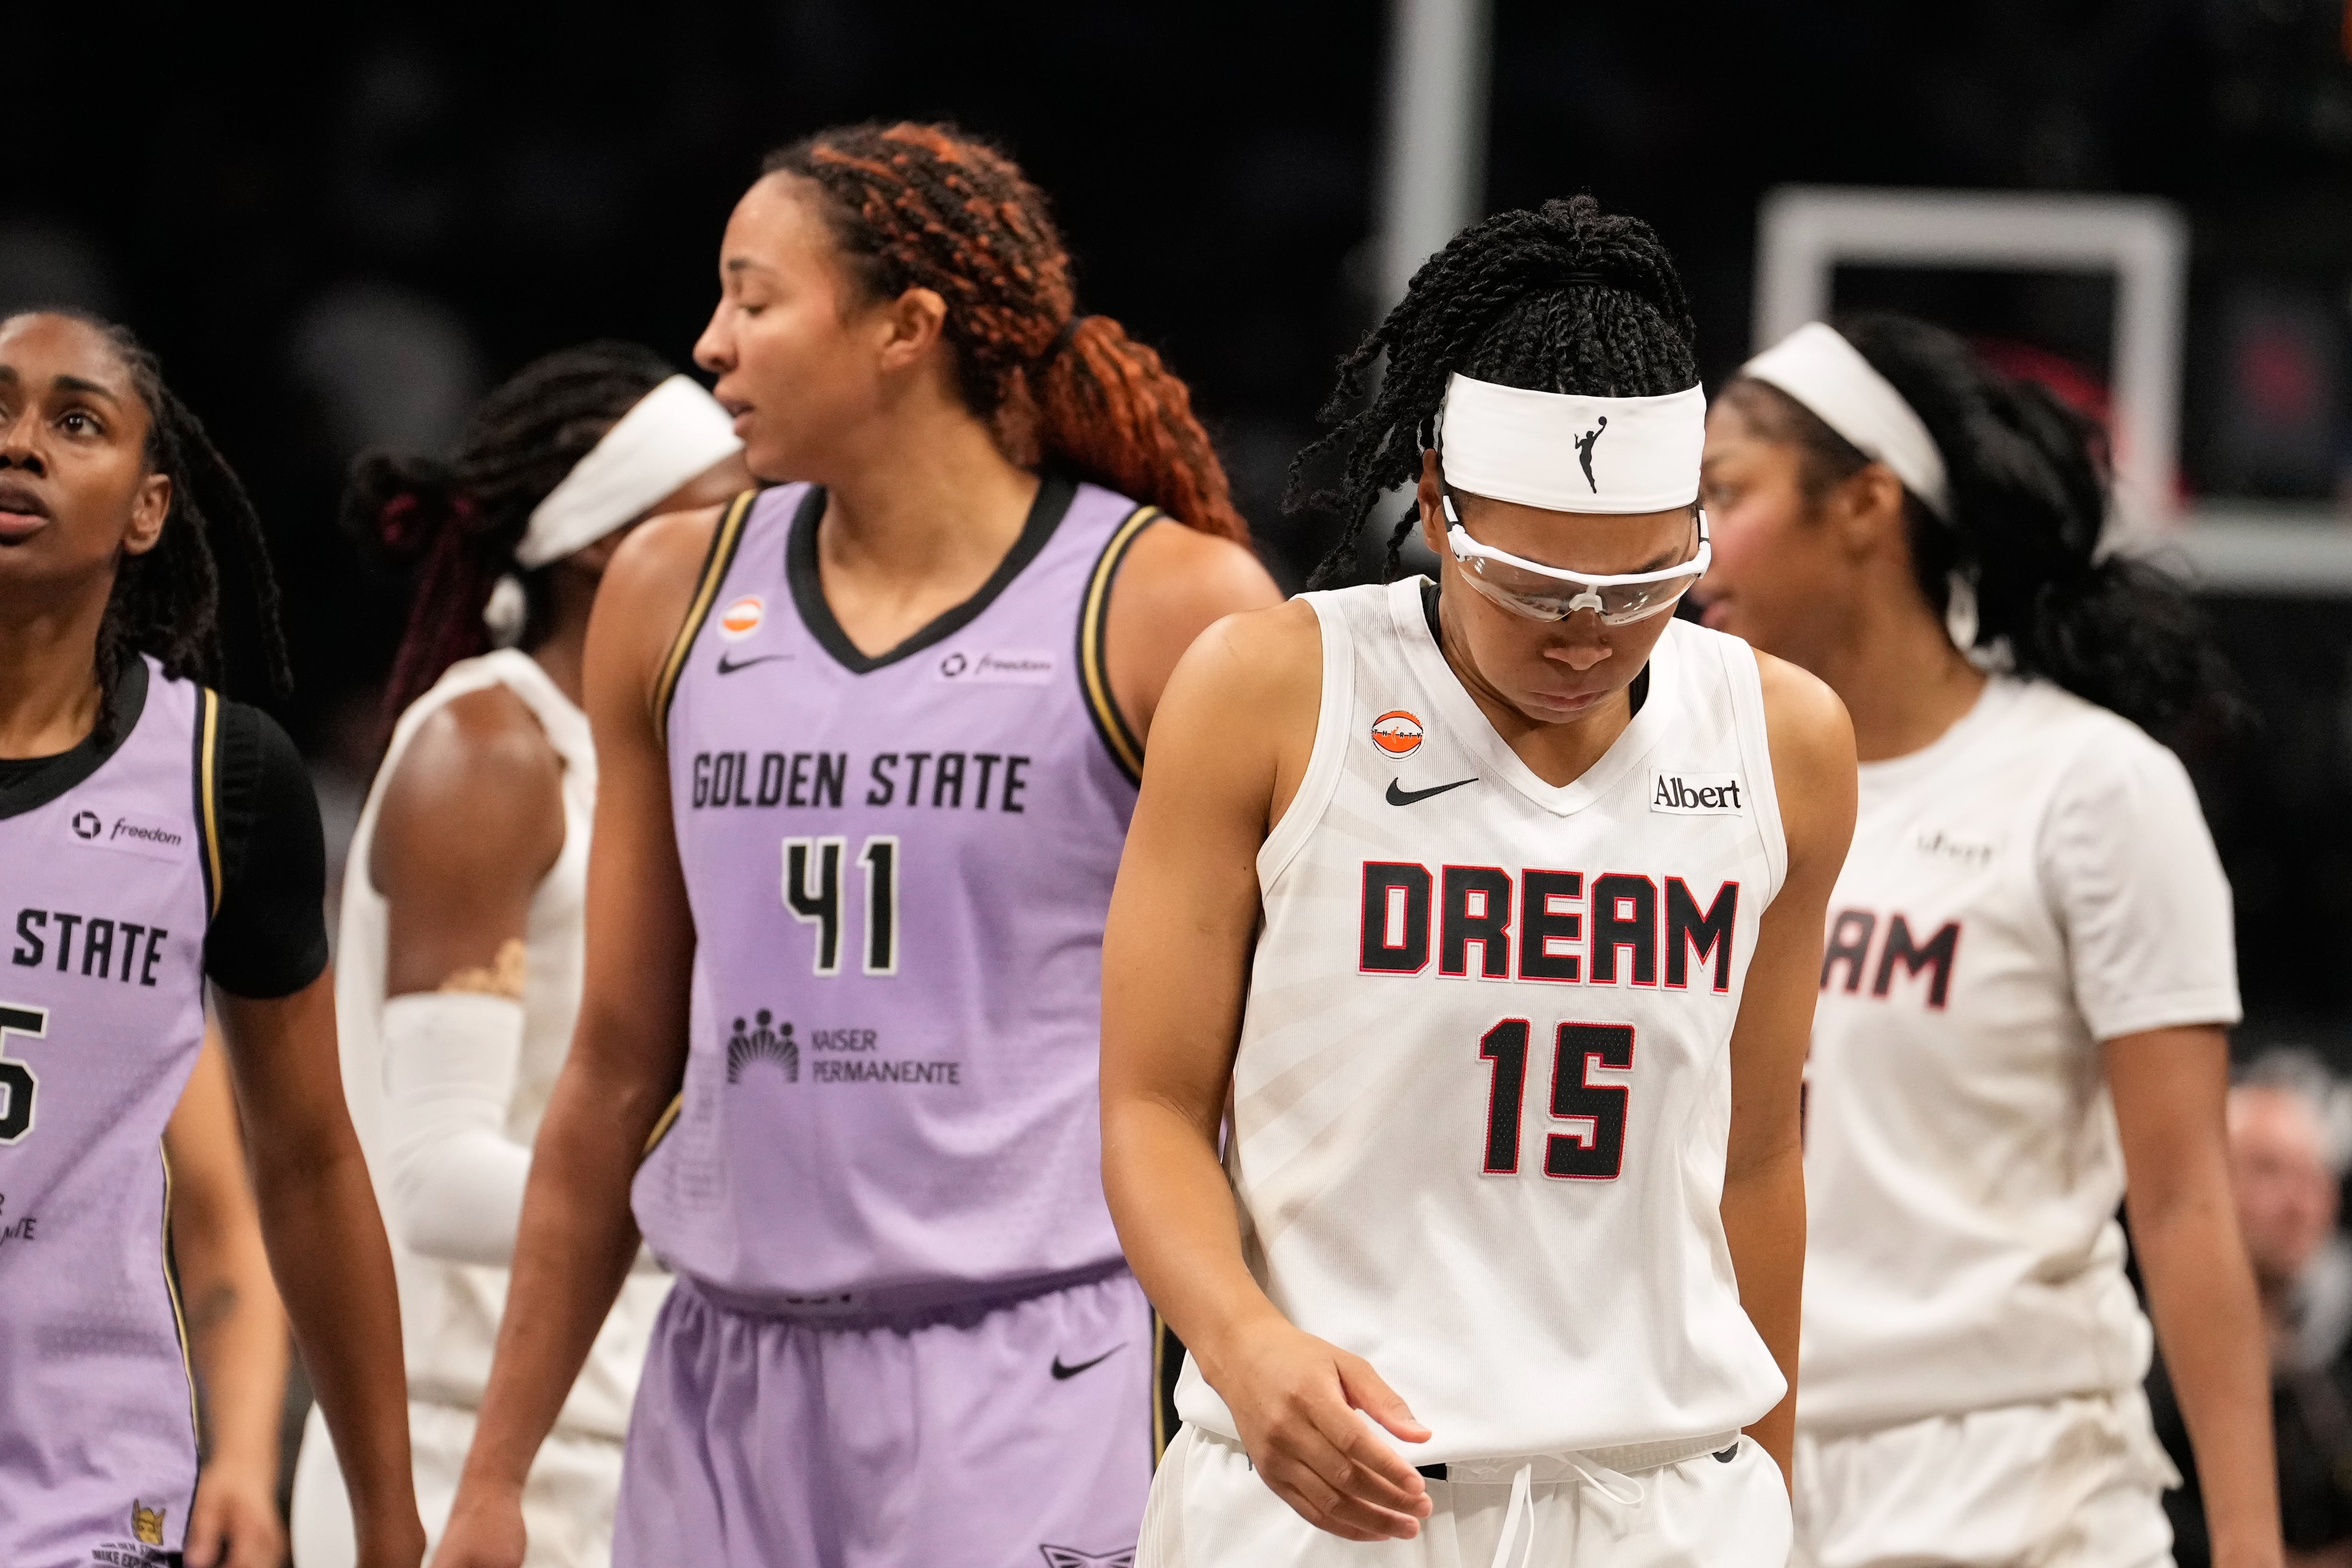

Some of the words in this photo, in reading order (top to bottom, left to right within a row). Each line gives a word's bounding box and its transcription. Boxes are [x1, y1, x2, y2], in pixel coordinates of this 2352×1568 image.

[692, 751, 847, 809] GOLDEN
[866, 752, 1033, 813] STATE
[1654, 774, 1741, 808] Albert
[110, 817, 182, 846] freedom
[782, 835, 900, 976] 41
[1357, 860, 1739, 996] DREAM
[12, 908, 168, 987] STATE
[813, 1060, 961, 1085] PERMANENTE
[1475, 1015, 1637, 1182] 15
